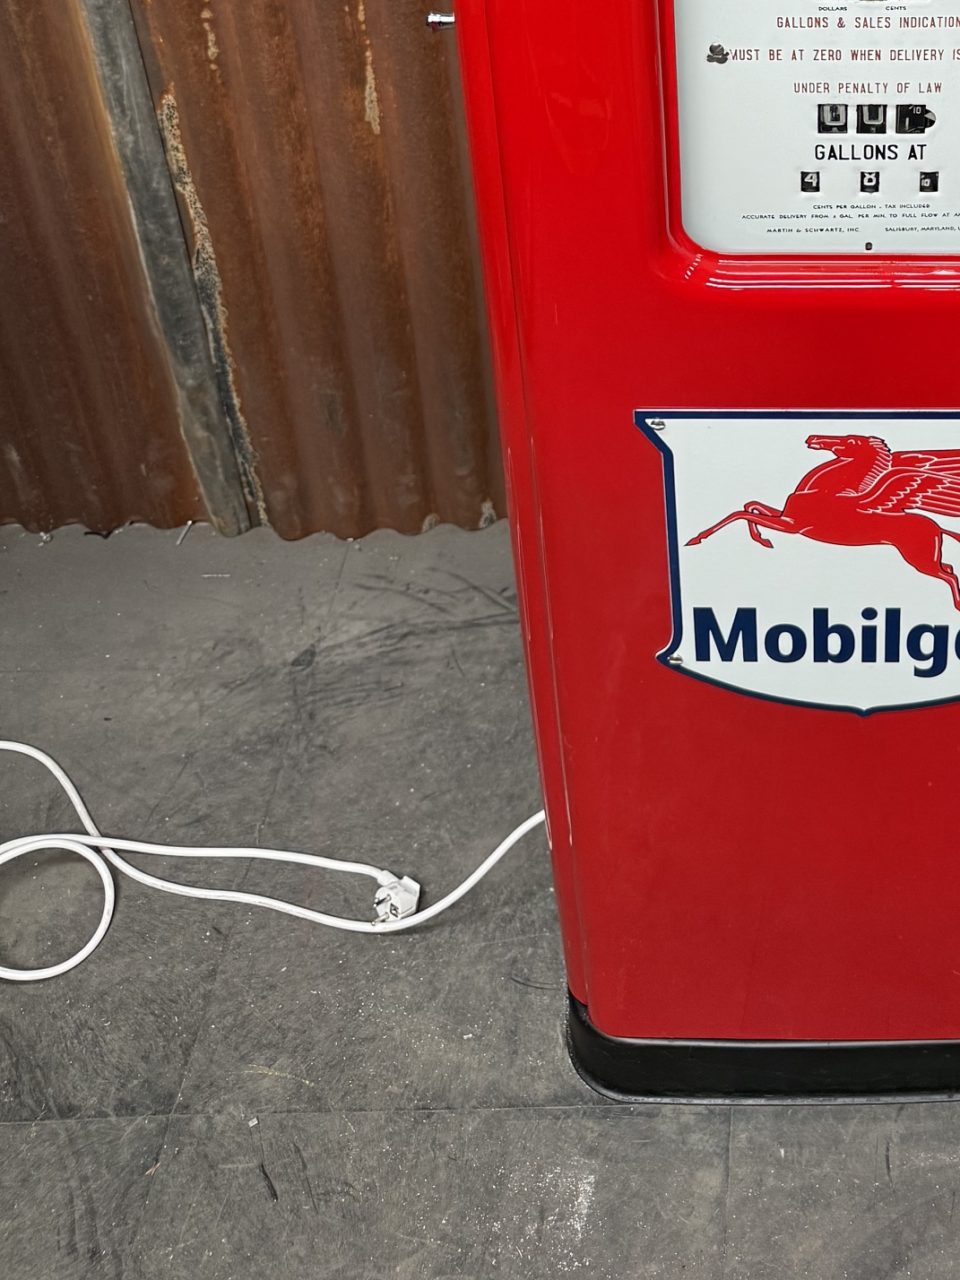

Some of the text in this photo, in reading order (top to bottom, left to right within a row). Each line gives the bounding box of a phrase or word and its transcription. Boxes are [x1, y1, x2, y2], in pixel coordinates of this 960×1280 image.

[776, 16, 829, 29] GALLONS
[836, 16, 847, 29] &
[854, 16, 891, 29] SALES
[729, 48, 761, 61] MUST
[768, 48, 783, 61] BE
[791, 48, 805, 62] AT
[812, 48, 842, 62] ZERO
[850, 48, 882, 62] WHEN
[889, 48, 945, 62] DELIVERY
[793, 81, 943, 95] UNDER PENALTY OF LAW
[814, 143, 928, 161] GALLONS AT
